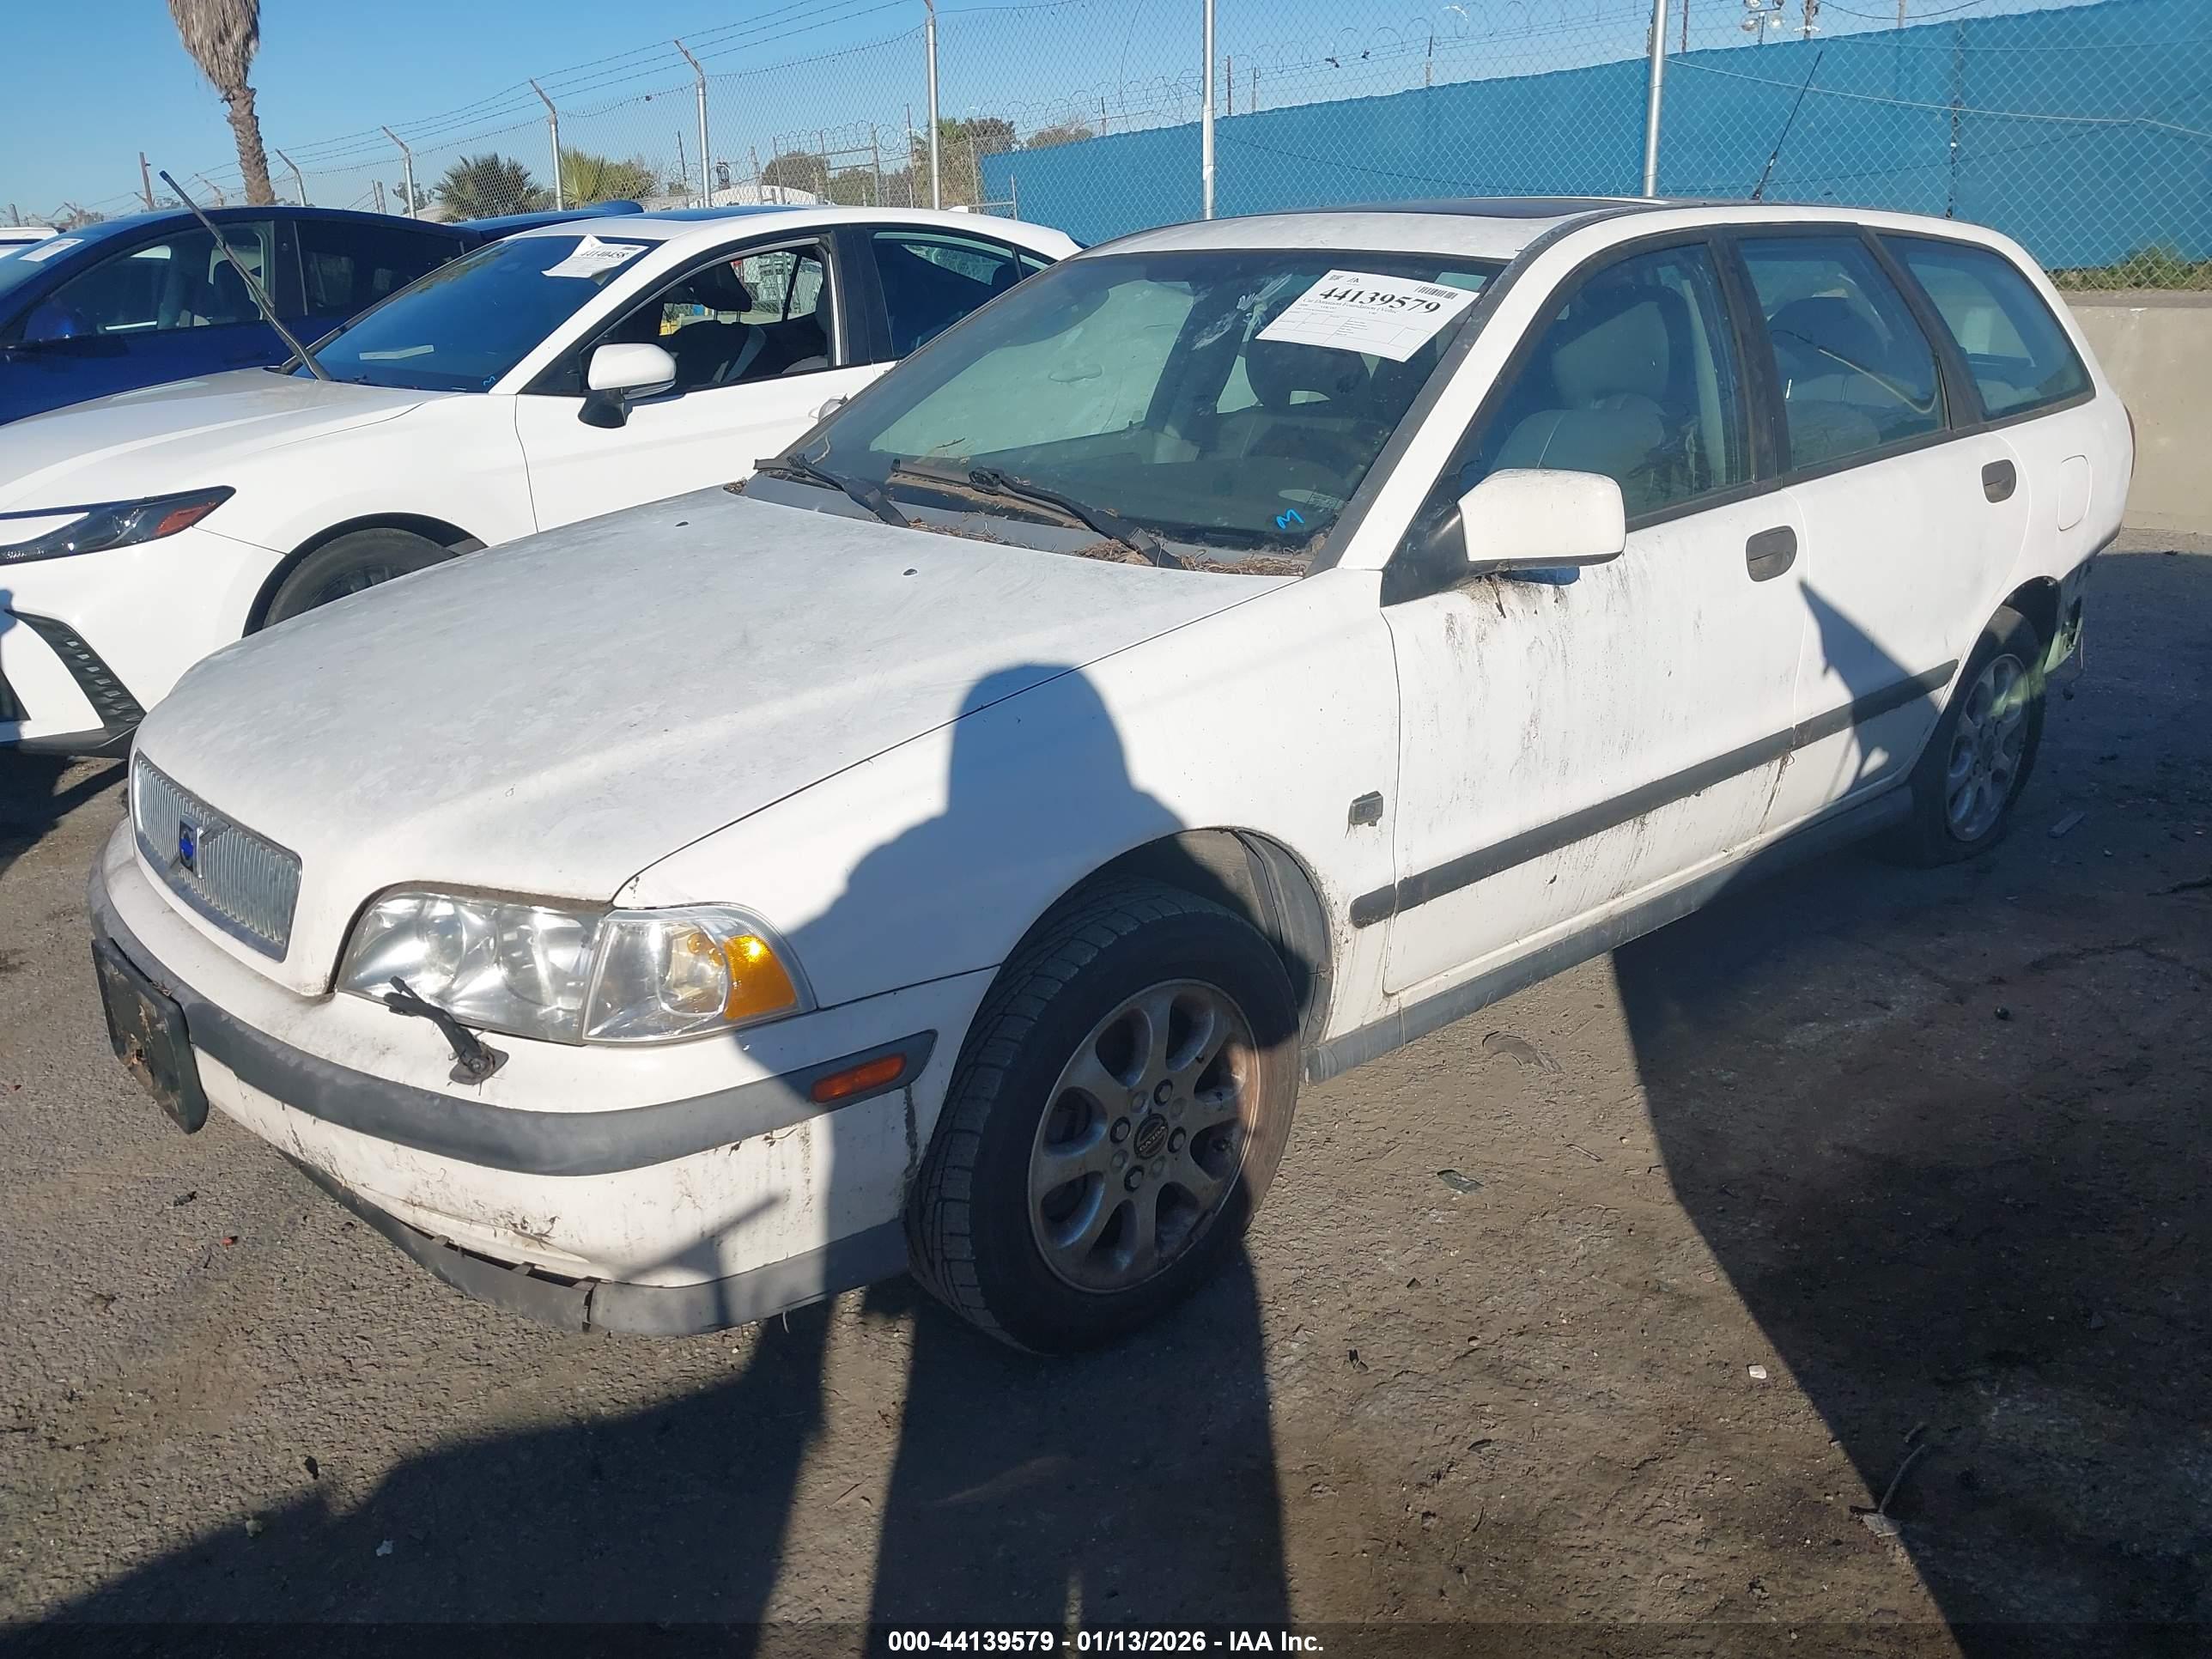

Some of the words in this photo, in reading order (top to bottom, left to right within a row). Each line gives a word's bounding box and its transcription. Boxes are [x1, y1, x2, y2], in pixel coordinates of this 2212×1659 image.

[1318, 287, 1442, 313] 44139579
[1276, 508, 1305, 530] M
[1139, 1126, 1167, 1152] VOLVO
